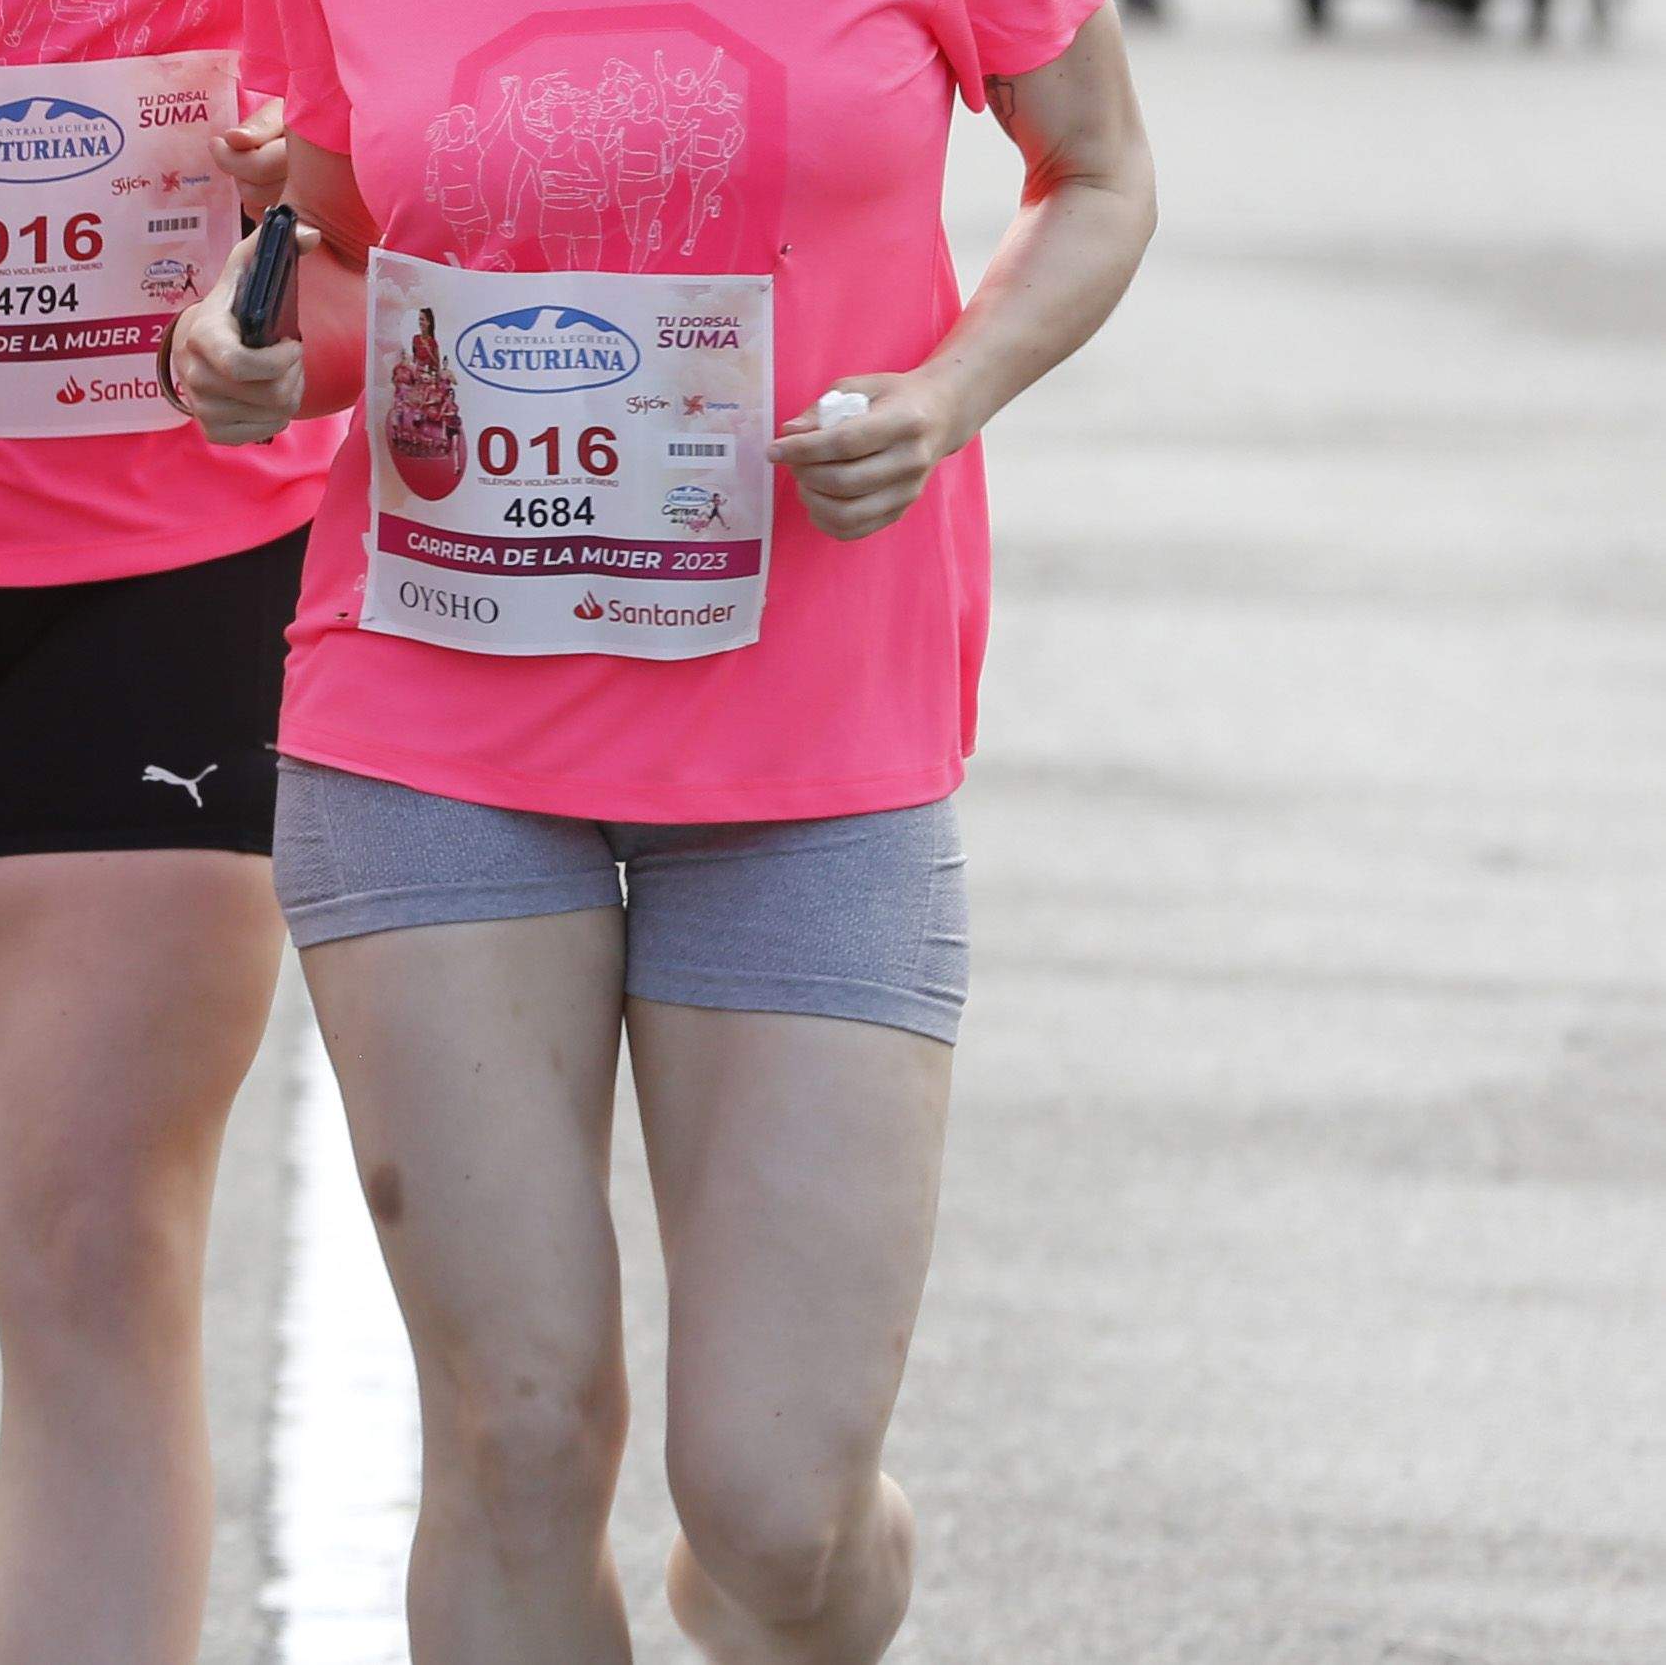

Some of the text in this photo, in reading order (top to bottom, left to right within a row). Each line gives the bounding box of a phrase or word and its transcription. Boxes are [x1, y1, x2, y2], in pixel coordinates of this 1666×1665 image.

[138, 90, 210, 107] TU DORSAL
[139, 103, 209, 128] SUMA
[49, 123, 106, 134] LECHERA
[656, 316, 741, 328] TU DORSAL
[29, 333, 58, 352] LA
[65, 327, 141, 350] MUJER
[494, 335, 619, 345] CENTRAL LECHERA
[656, 329, 739, 349] SUMA
[468, 336, 626, 371] ASTURIANA
[478, 426, 619, 476] 016
[504, 496, 595, 528] 4684
[407, 532, 729, 571] CARRERA DE LA MUJER 2023
[400, 581, 498, 624] OYSHO
[608, 600, 736, 626] Santander
